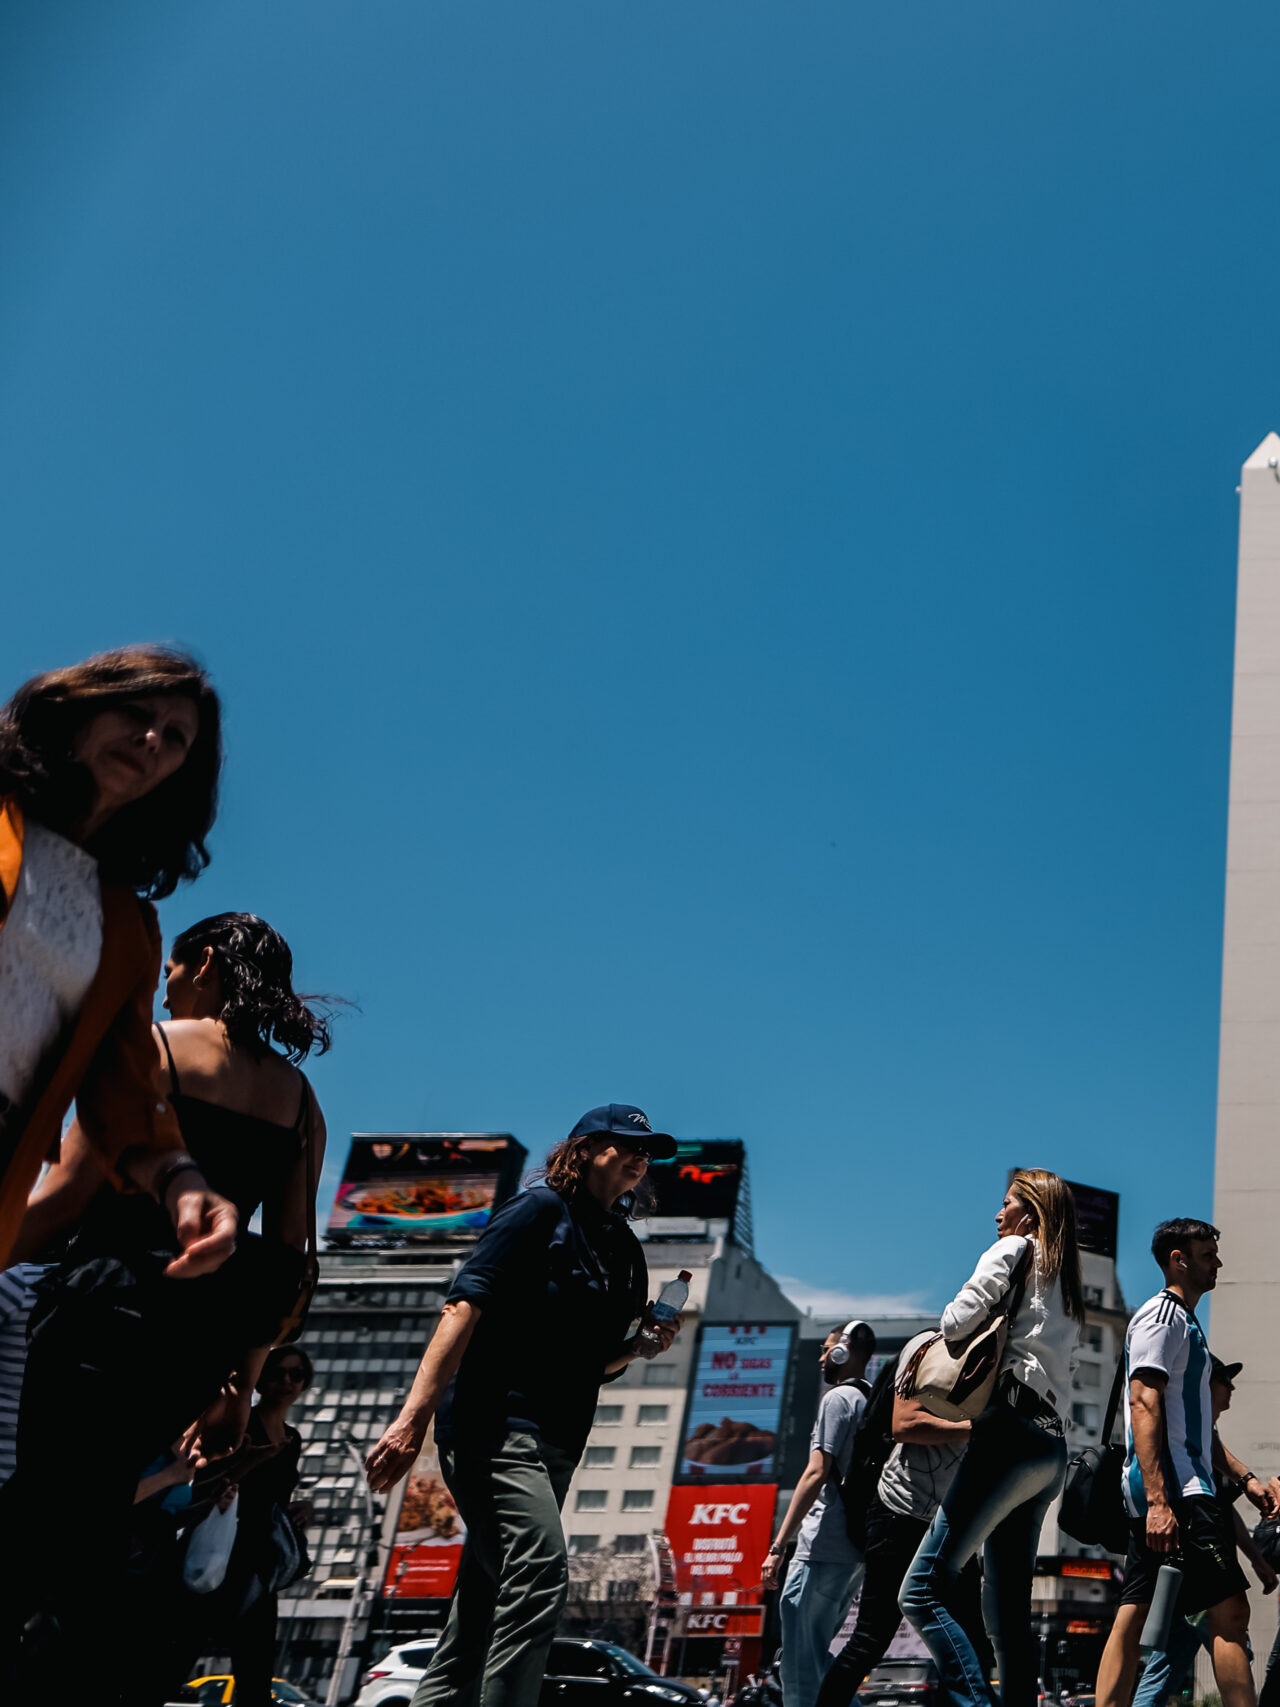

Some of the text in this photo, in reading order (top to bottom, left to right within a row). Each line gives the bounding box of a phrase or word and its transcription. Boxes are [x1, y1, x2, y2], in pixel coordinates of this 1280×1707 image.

[712, 1351, 737, 1370] NO
[688, 1503, 750, 1525] KFC
[686, 1614, 728, 1629] KFC
